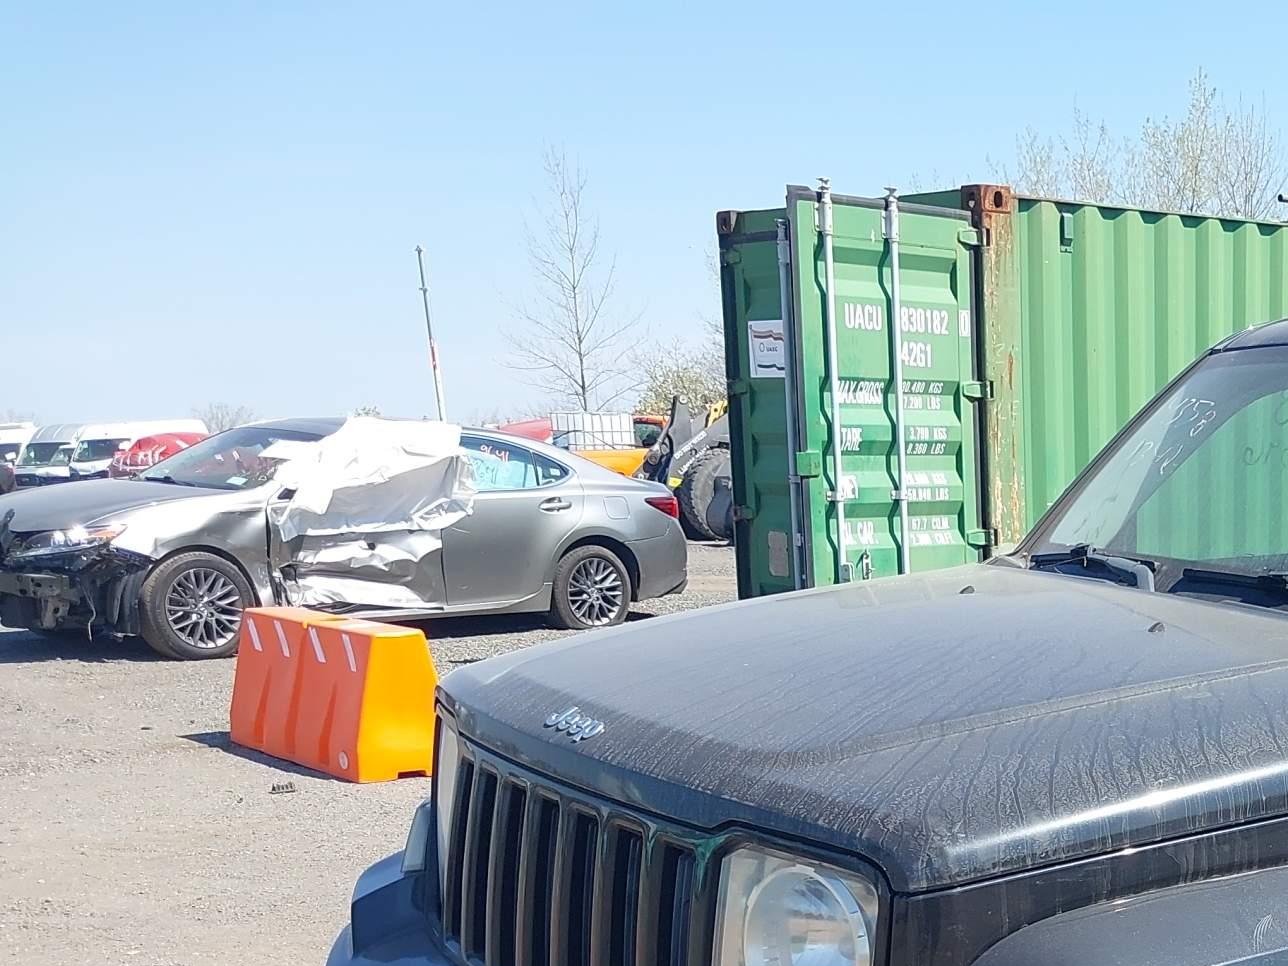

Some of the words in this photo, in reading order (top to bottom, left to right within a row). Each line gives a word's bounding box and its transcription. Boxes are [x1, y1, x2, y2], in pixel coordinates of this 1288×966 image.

[844, 302, 882, 331] UACU
[900, 306, 949, 335] 830182
[900, 341, 932, 368] 42G1
[841, 427, 862, 452] TARE
[930, 443, 946, 455] LBS
[544, 705, 606, 743] Jeep
